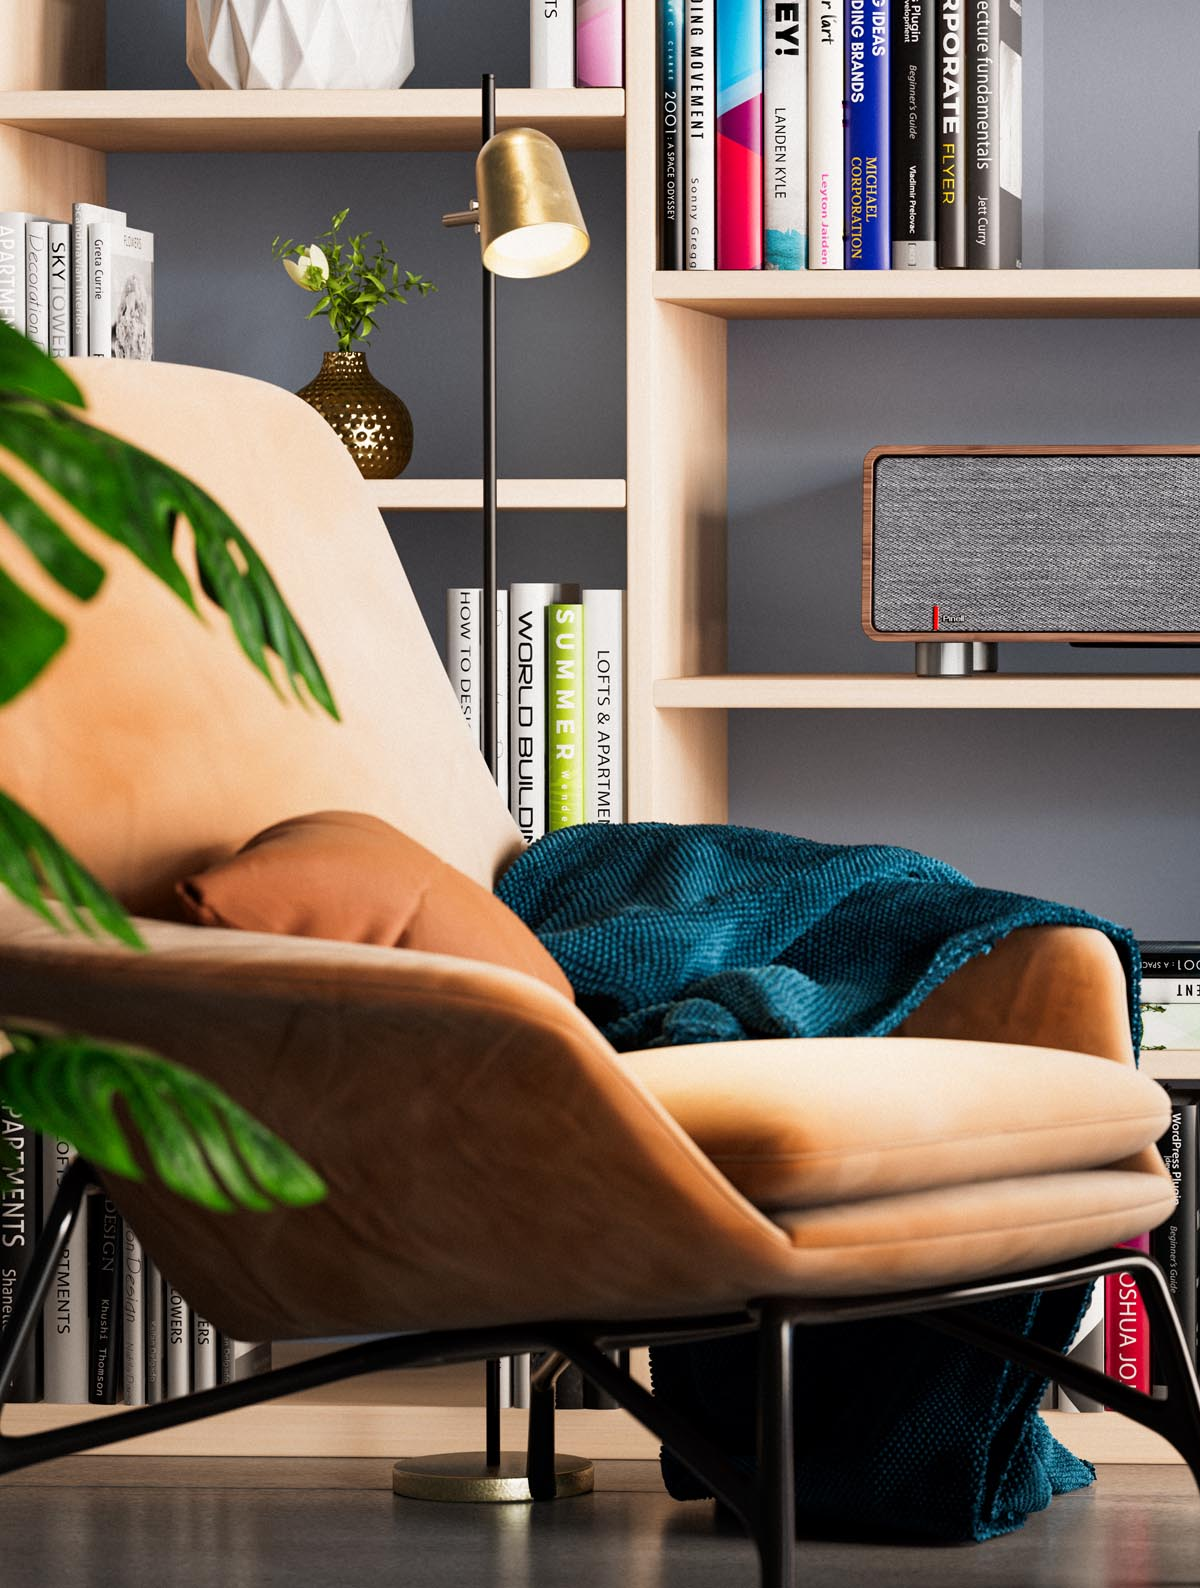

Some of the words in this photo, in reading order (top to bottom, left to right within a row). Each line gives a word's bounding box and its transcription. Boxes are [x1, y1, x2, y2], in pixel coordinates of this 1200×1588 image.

[872, 11, 886, 57] IDEAS
[909, 5, 921, 43] Plugin
[977, 0, 990, 53] ecture
[690, 46, 704, 139] MOVEMENT
[851, 42, 864, 103] BRANDS
[909, 64, 917, 111] Beginner's
[774, 107, 786, 162] LANDEN
[909, 112, 917, 140] Guide
[977, 57, 992, 170] fundamentals
[667, 151, 675, 178] SPACE
[774, 167, 787, 199] KYLE
[942, 143, 955, 205] FLYER
[667, 181, 675, 221] ODYSSEY
[690, 177, 699, 220] Sonny
[819, 173, 829, 219] Leyton
[851, 156, 863, 259] CORPORATION
[866, 156, 877, 223] MICHAEL
[977, 195, 988, 215] Jett
[94, 239, 104, 267] Greta
[820, 221, 829, 265] Jaiden
[976, 217, 989, 246] Curry
[28, 234, 44, 335] Decoration
[94, 268, 104, 300] Currie
[460, 592, 471, 640] HOW
[460, 646, 471, 673] TO
[518, 610, 533, 727] WORLD
[597, 650, 610, 706] LOFTS
[555, 608, 575, 760] SUMMER
[597, 712, 611, 725] &
[1171, 1112, 1182, 1169] WordPress
[1168, 1225, 1178, 1268] Beginner's
[1169, 1269, 1179, 1294] Guide
[100, 1299, 110, 1340] Khushi
[97, 1347, 108, 1397] Thomson
